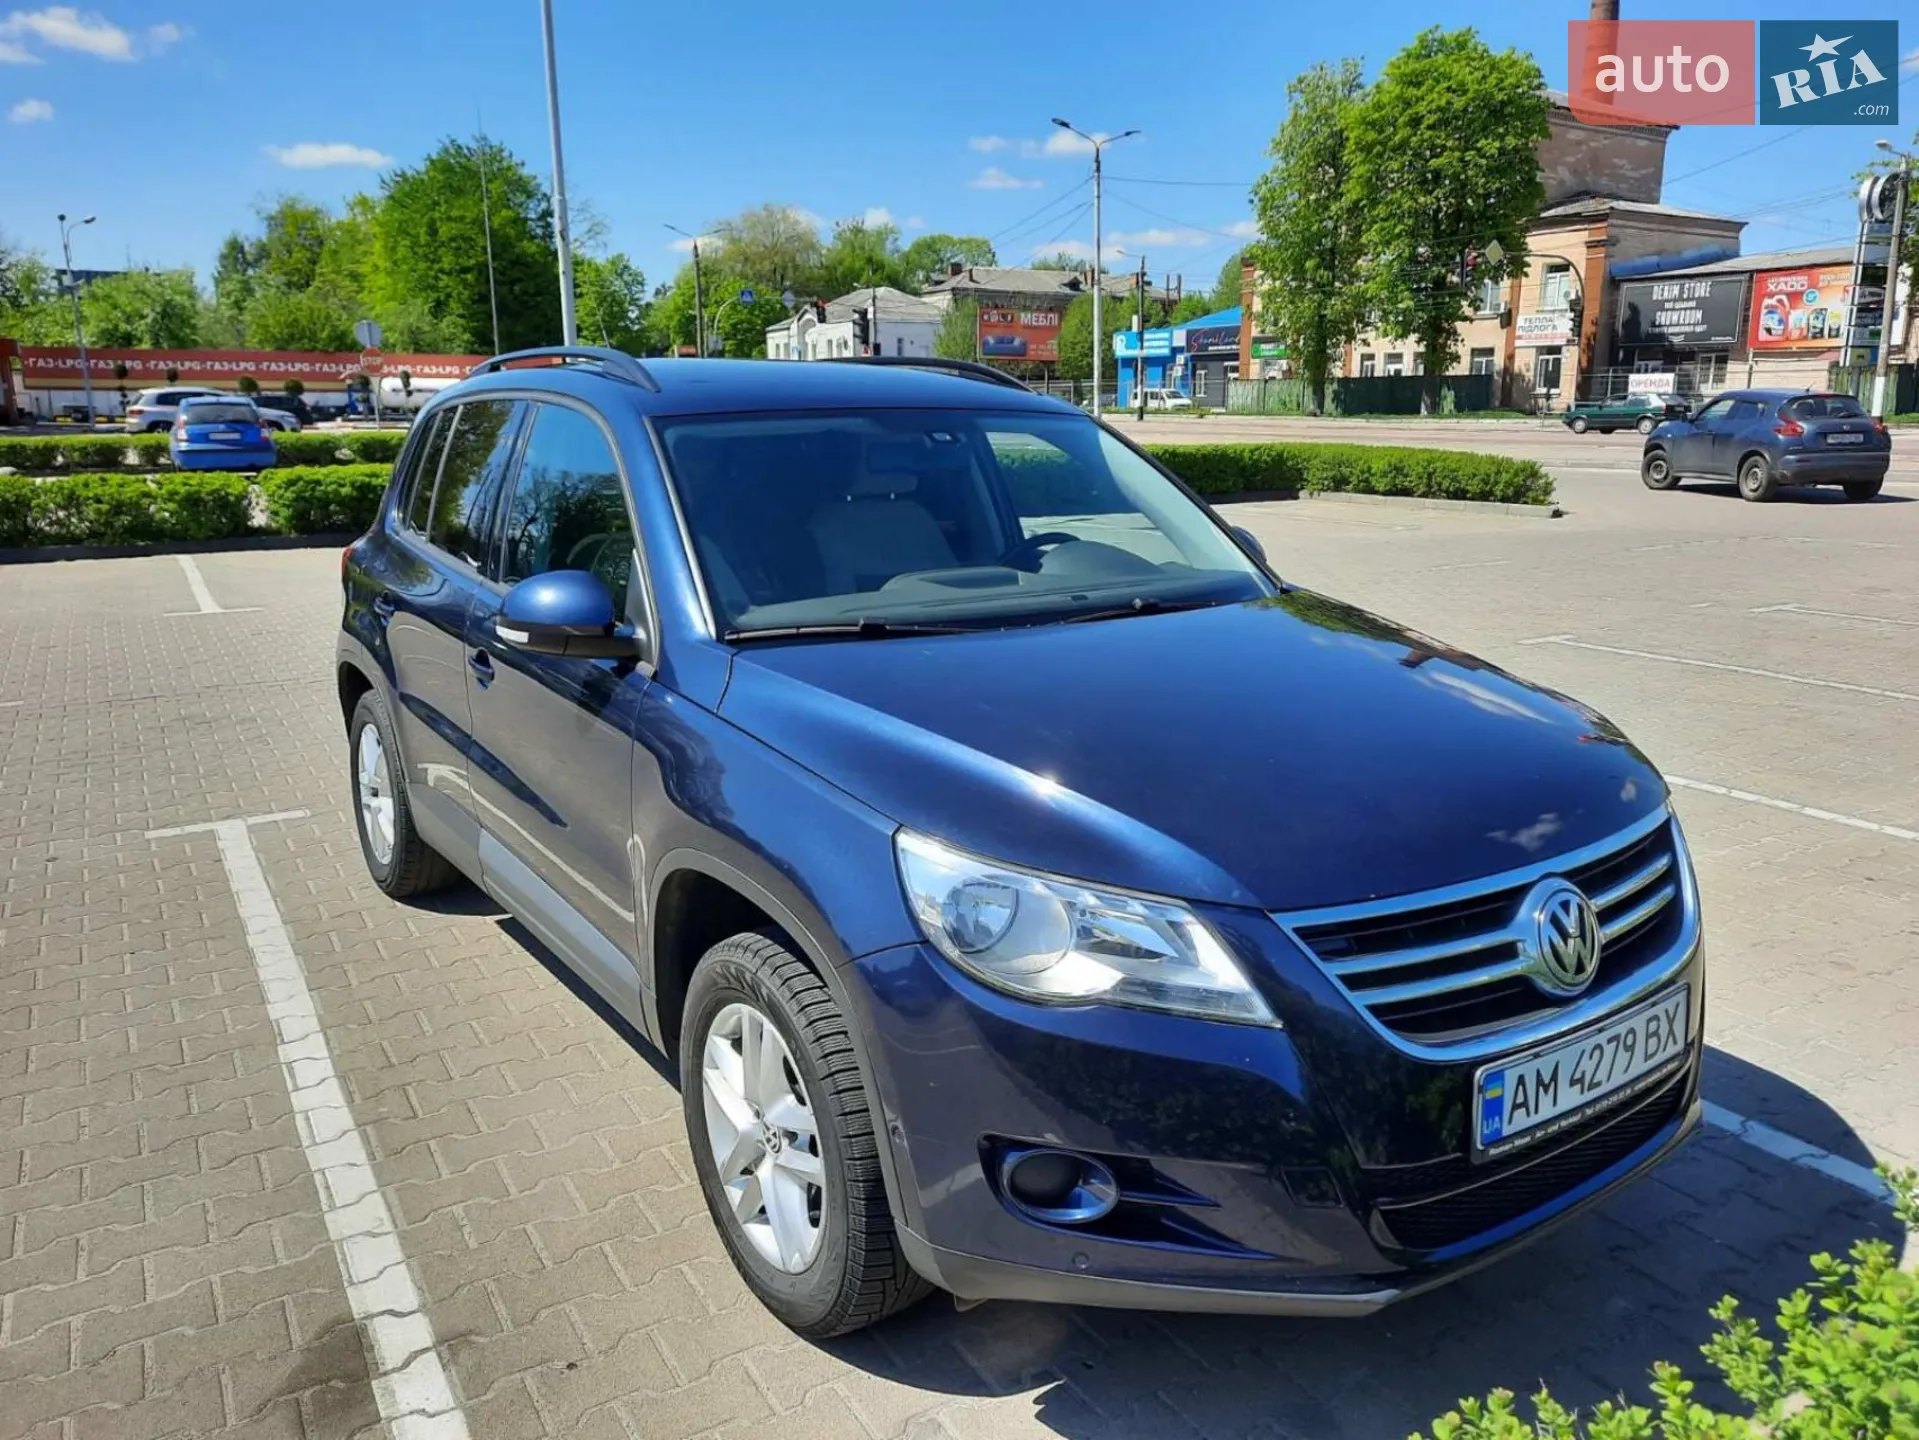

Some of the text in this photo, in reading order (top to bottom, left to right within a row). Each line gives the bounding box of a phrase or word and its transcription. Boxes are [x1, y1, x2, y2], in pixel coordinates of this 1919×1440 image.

[1683, 281, 1711, 299] STORE
[1767, 281, 1808, 291] XADO
[1020, 312, 1059, 326] МЕБЛІ
[1655, 309, 1703, 325] SHOWROOM
[1517, 324, 1558, 333] ПІДЛОГА
[1630, 378, 1671, 388] ОРЕНДА
[1508, 1060, 1560, 1125] AM
[1568, 1026, 1637, 1096] 4279
[1644, 1001, 1680, 1063] BX
[1483, 1116, 1501, 1134] UA
